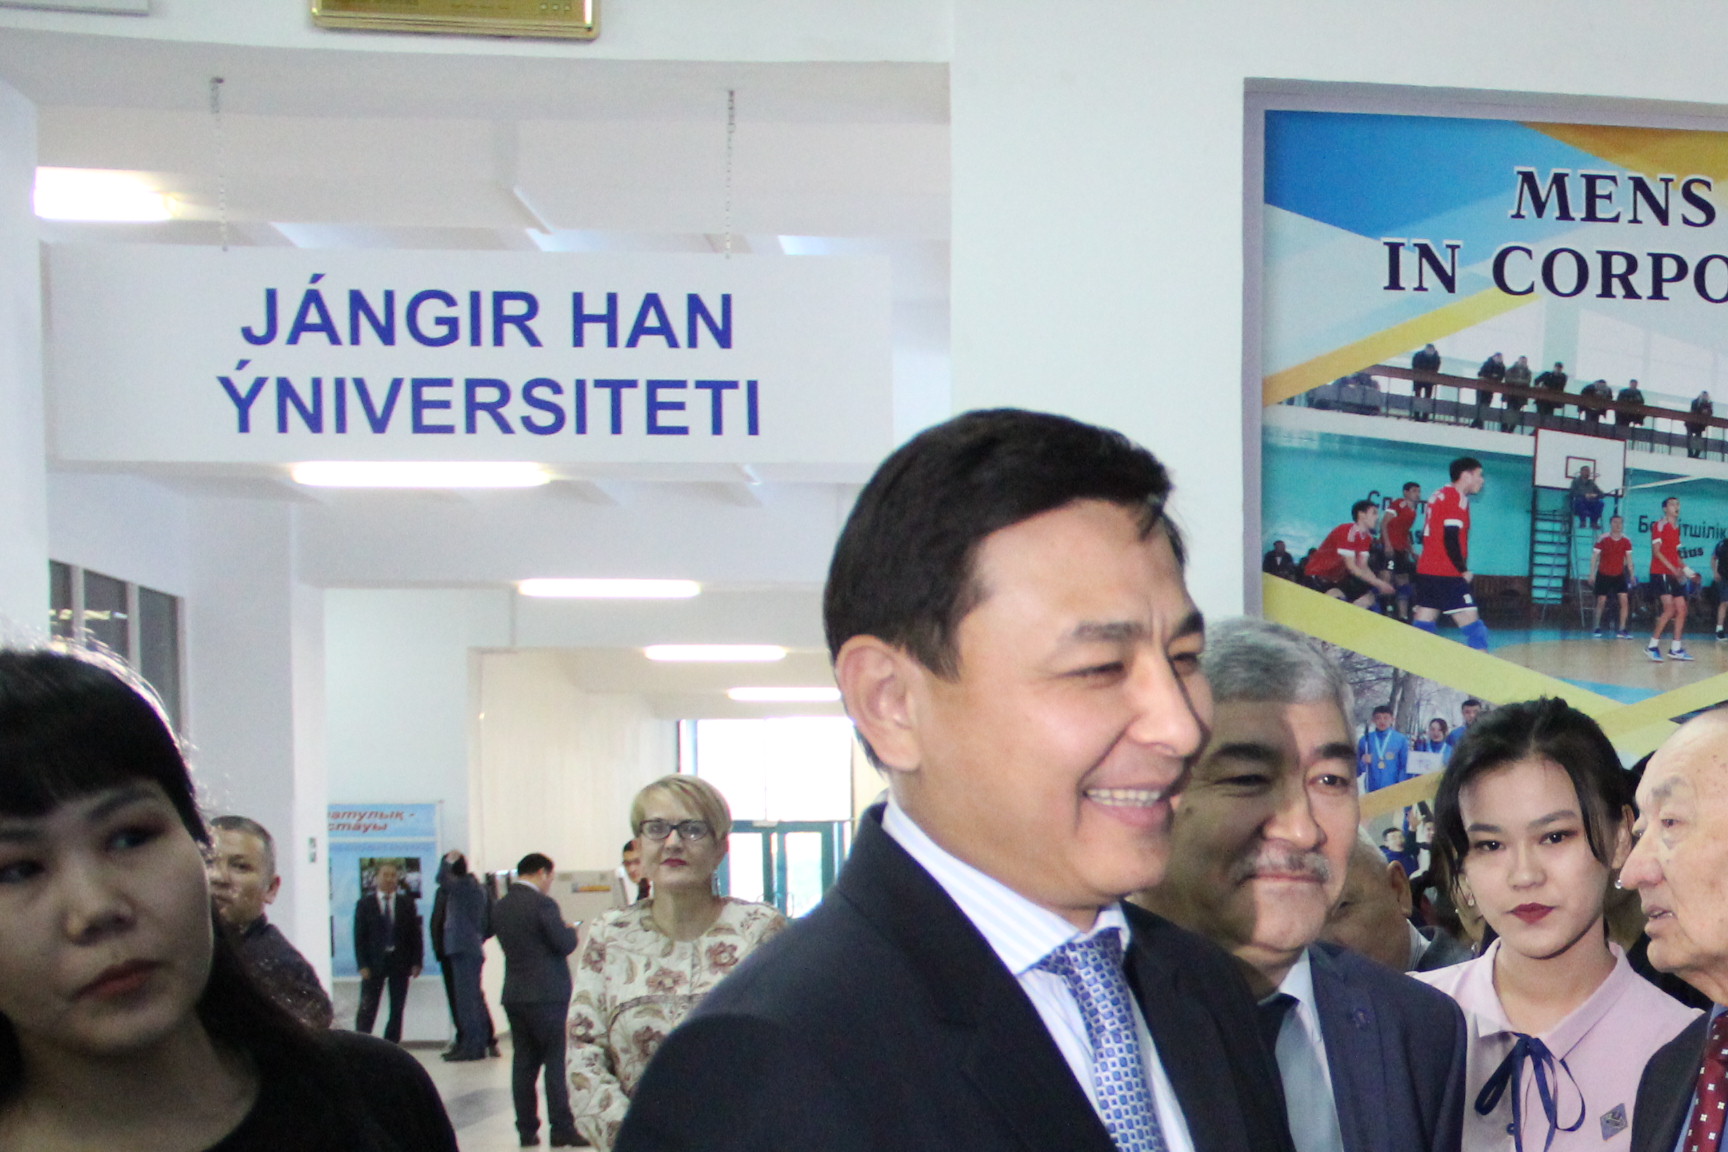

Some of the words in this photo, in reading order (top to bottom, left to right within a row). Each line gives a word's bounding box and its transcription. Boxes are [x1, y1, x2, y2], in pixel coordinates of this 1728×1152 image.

[1512, 168, 1718, 228] MENS
[1381, 241, 1460, 294] IN
[241, 273, 543, 348] JÁNGIR
[571, 292, 732, 350] HAN
[217, 359, 760, 436] ÝNIVERSITETI
[328, 811, 404, 821] атулық
